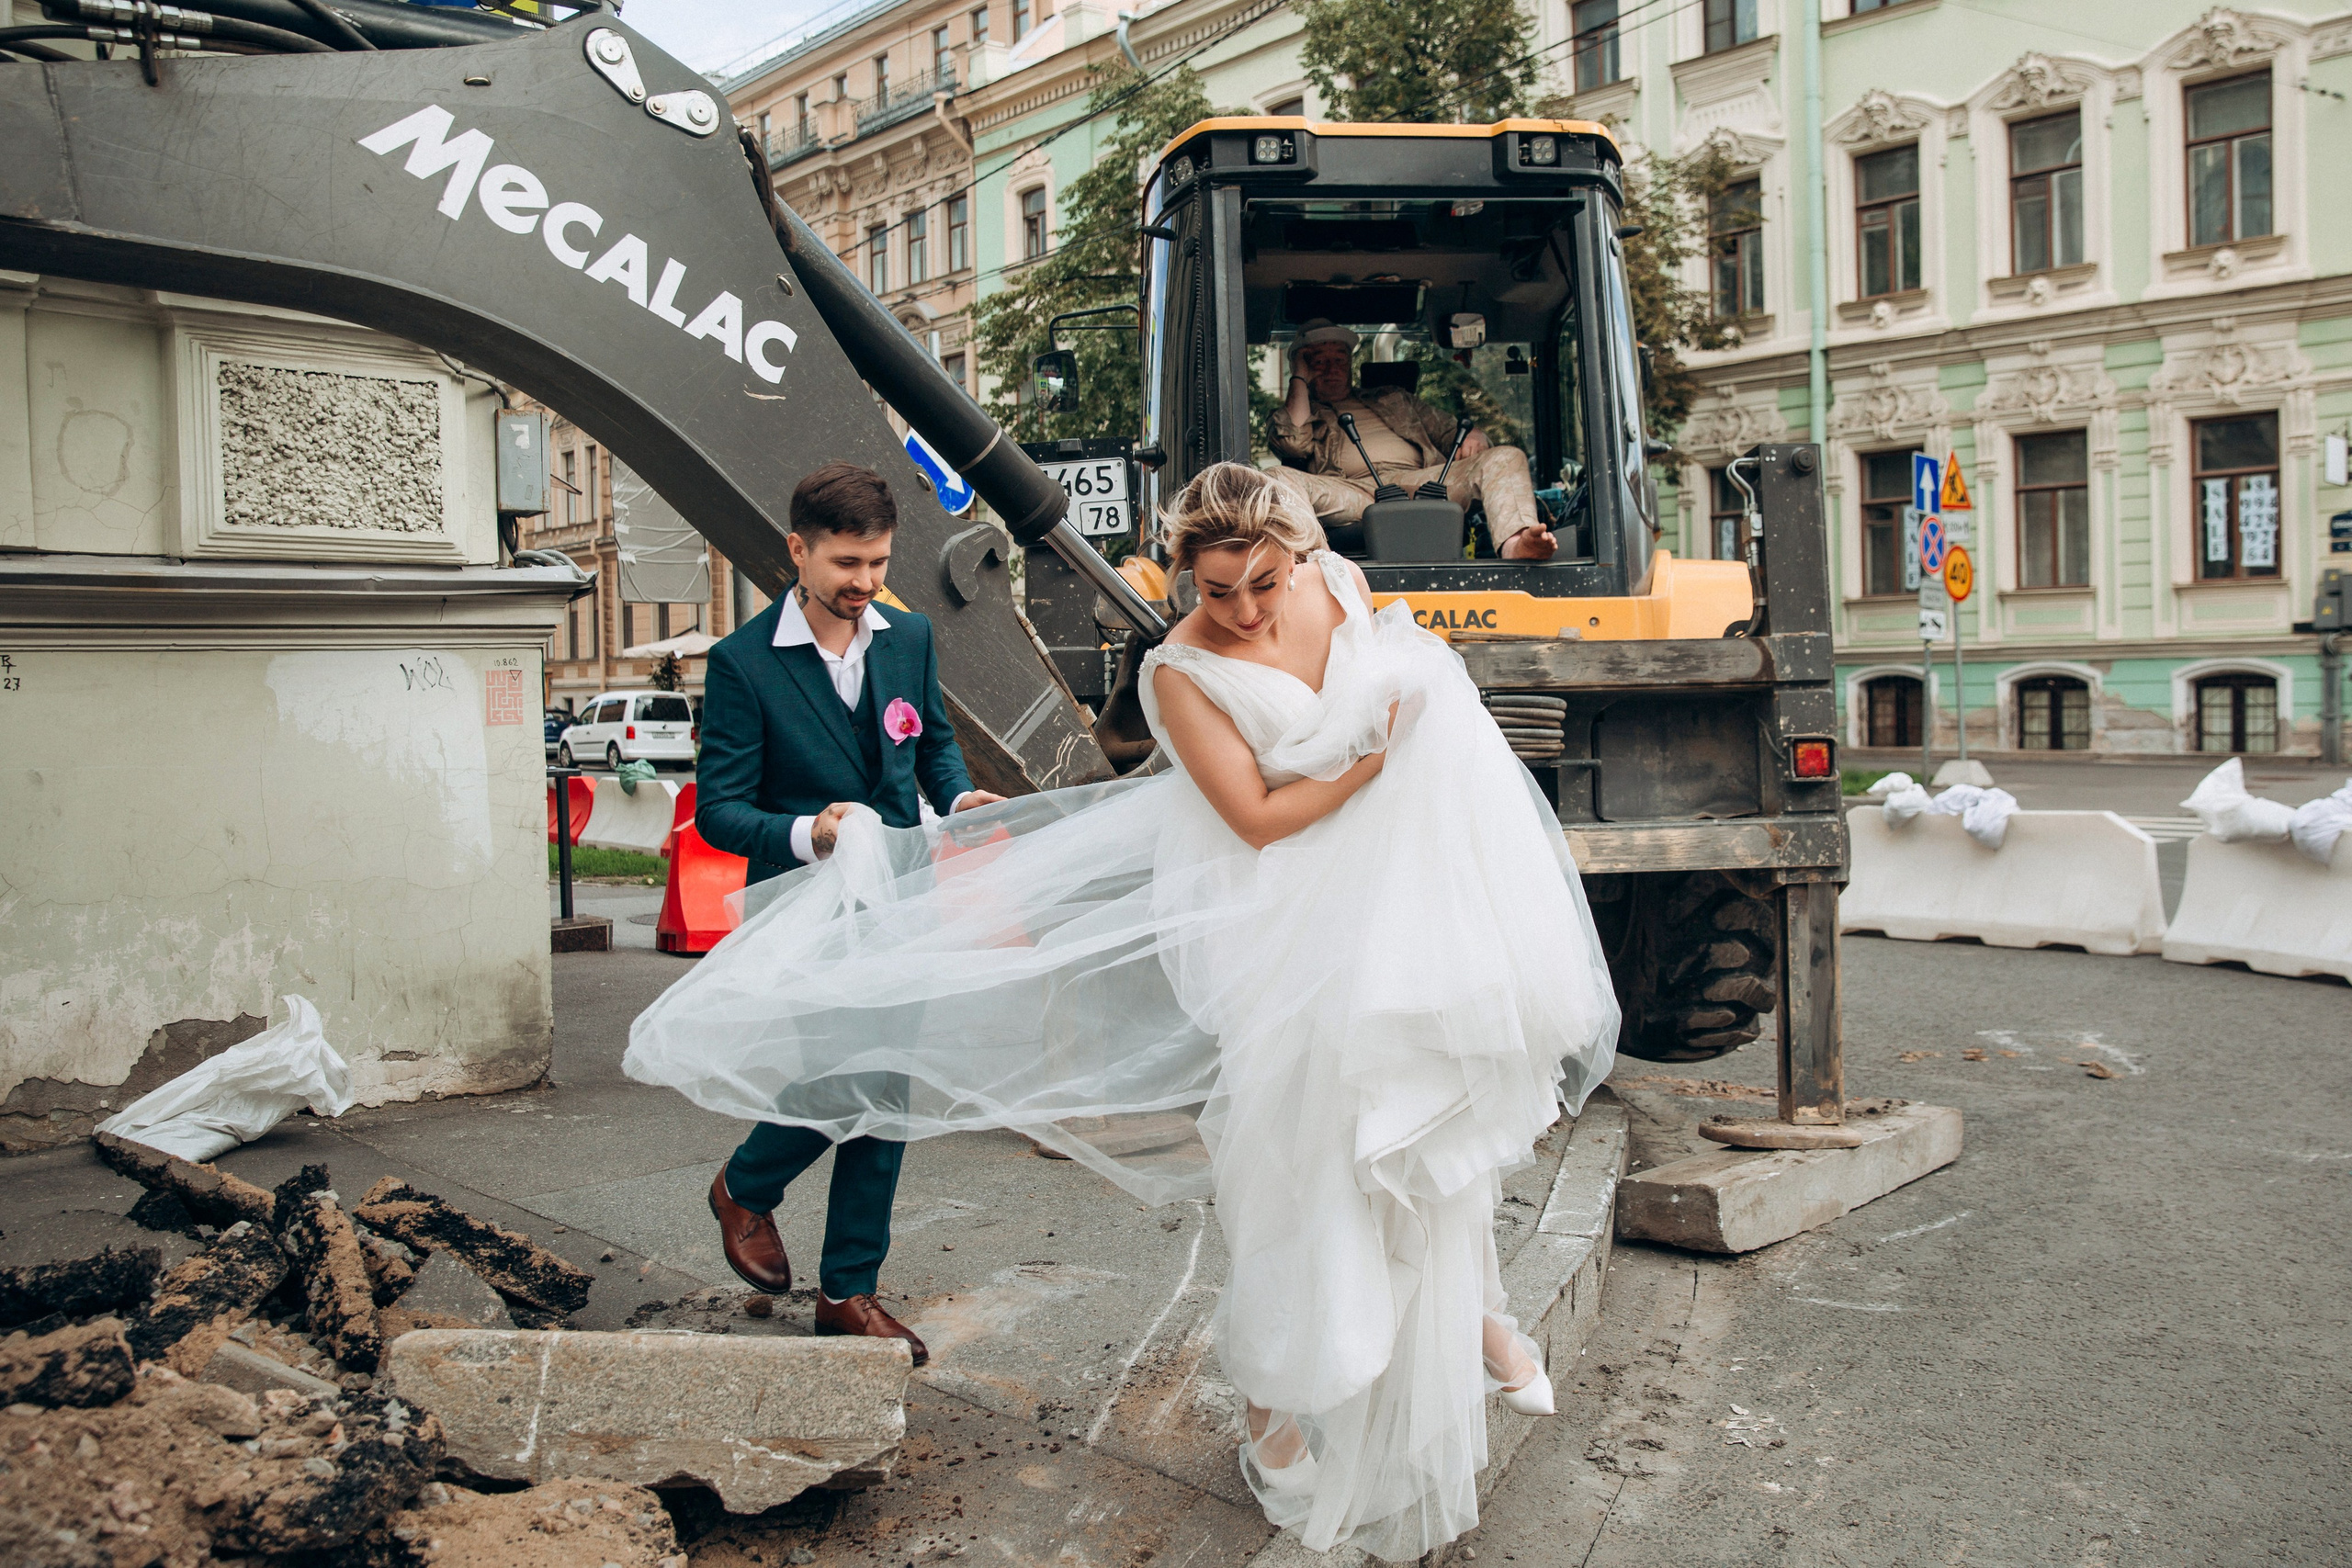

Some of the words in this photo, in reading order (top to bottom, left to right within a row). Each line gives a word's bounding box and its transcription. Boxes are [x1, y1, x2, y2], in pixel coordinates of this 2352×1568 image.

[357, 104, 797, 383] MeCALAC
[1043, 465, 1114, 497] 465
[1089, 506, 1120, 530] 78
[1950, 563, 1968, 584] 40
[1374, 607, 1497, 629] CALAC
